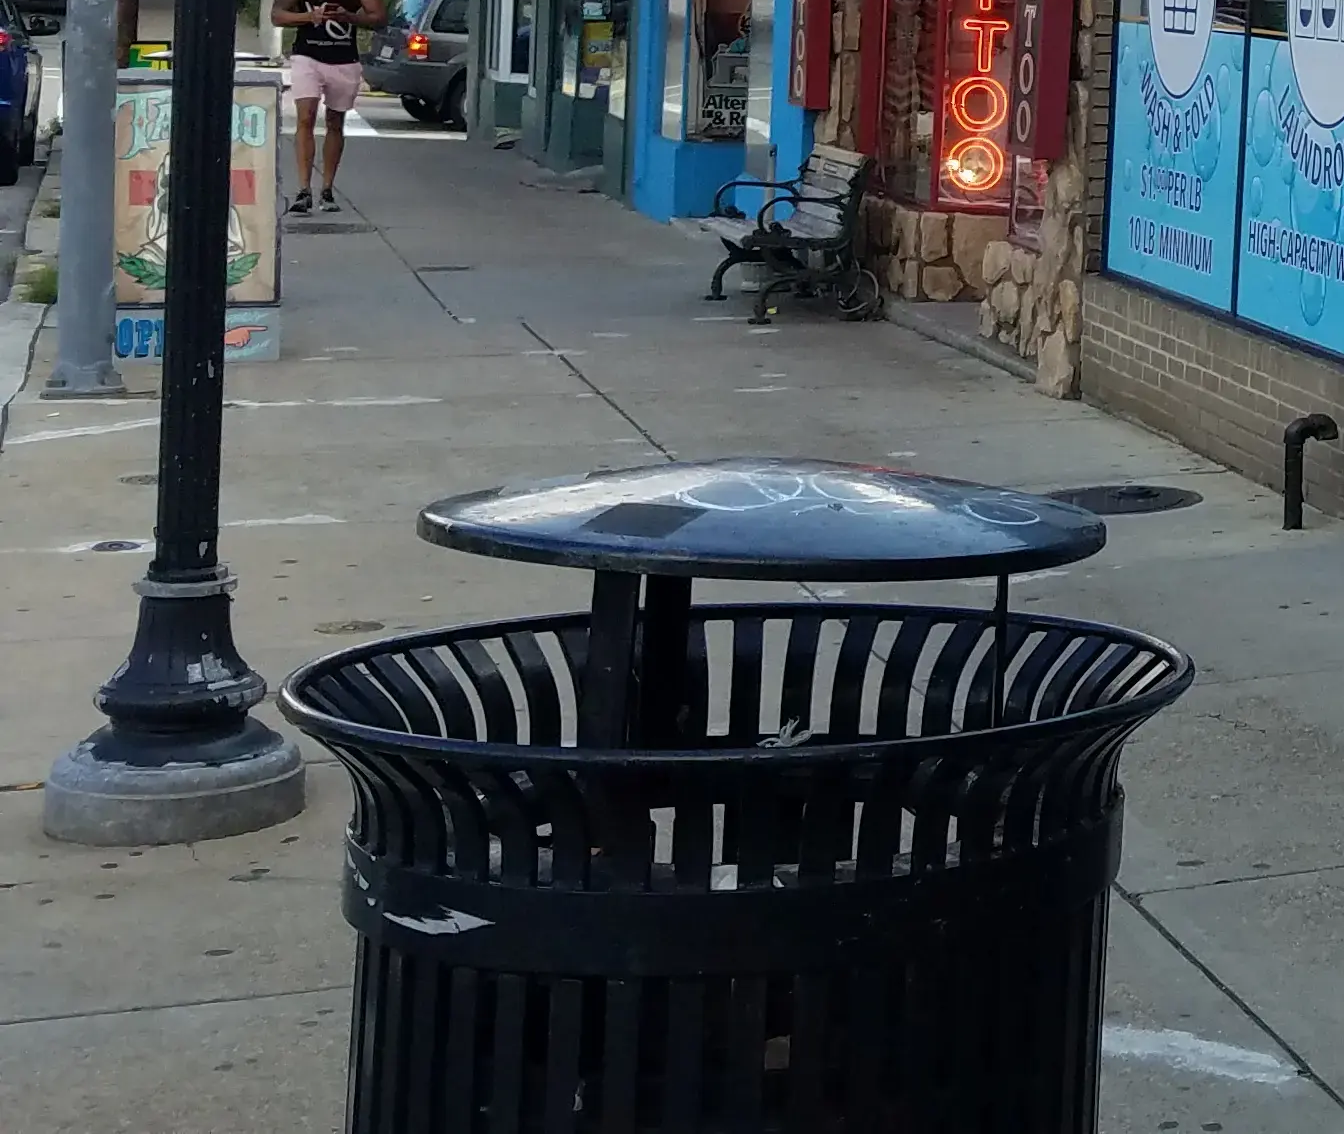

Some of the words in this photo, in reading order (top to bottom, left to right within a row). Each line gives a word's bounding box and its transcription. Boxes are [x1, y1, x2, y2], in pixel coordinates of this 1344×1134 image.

[704, 94, 746, 110] Alter
[1140, 67, 1170, 149] WASH
[1173, 116, 1182, 153] &
[1185, 76, 1215, 147] FOLD
[1168, 171, 1187, 208] PER
[1189, 176, 1202, 213] LB
[1129, 217, 1142, 252] 10
[1143, 222, 1155, 255] LB
[1160, 225, 1213, 274] MINIMUM
[1249, 222, 1333, 279] HIGH-CAPACITY
